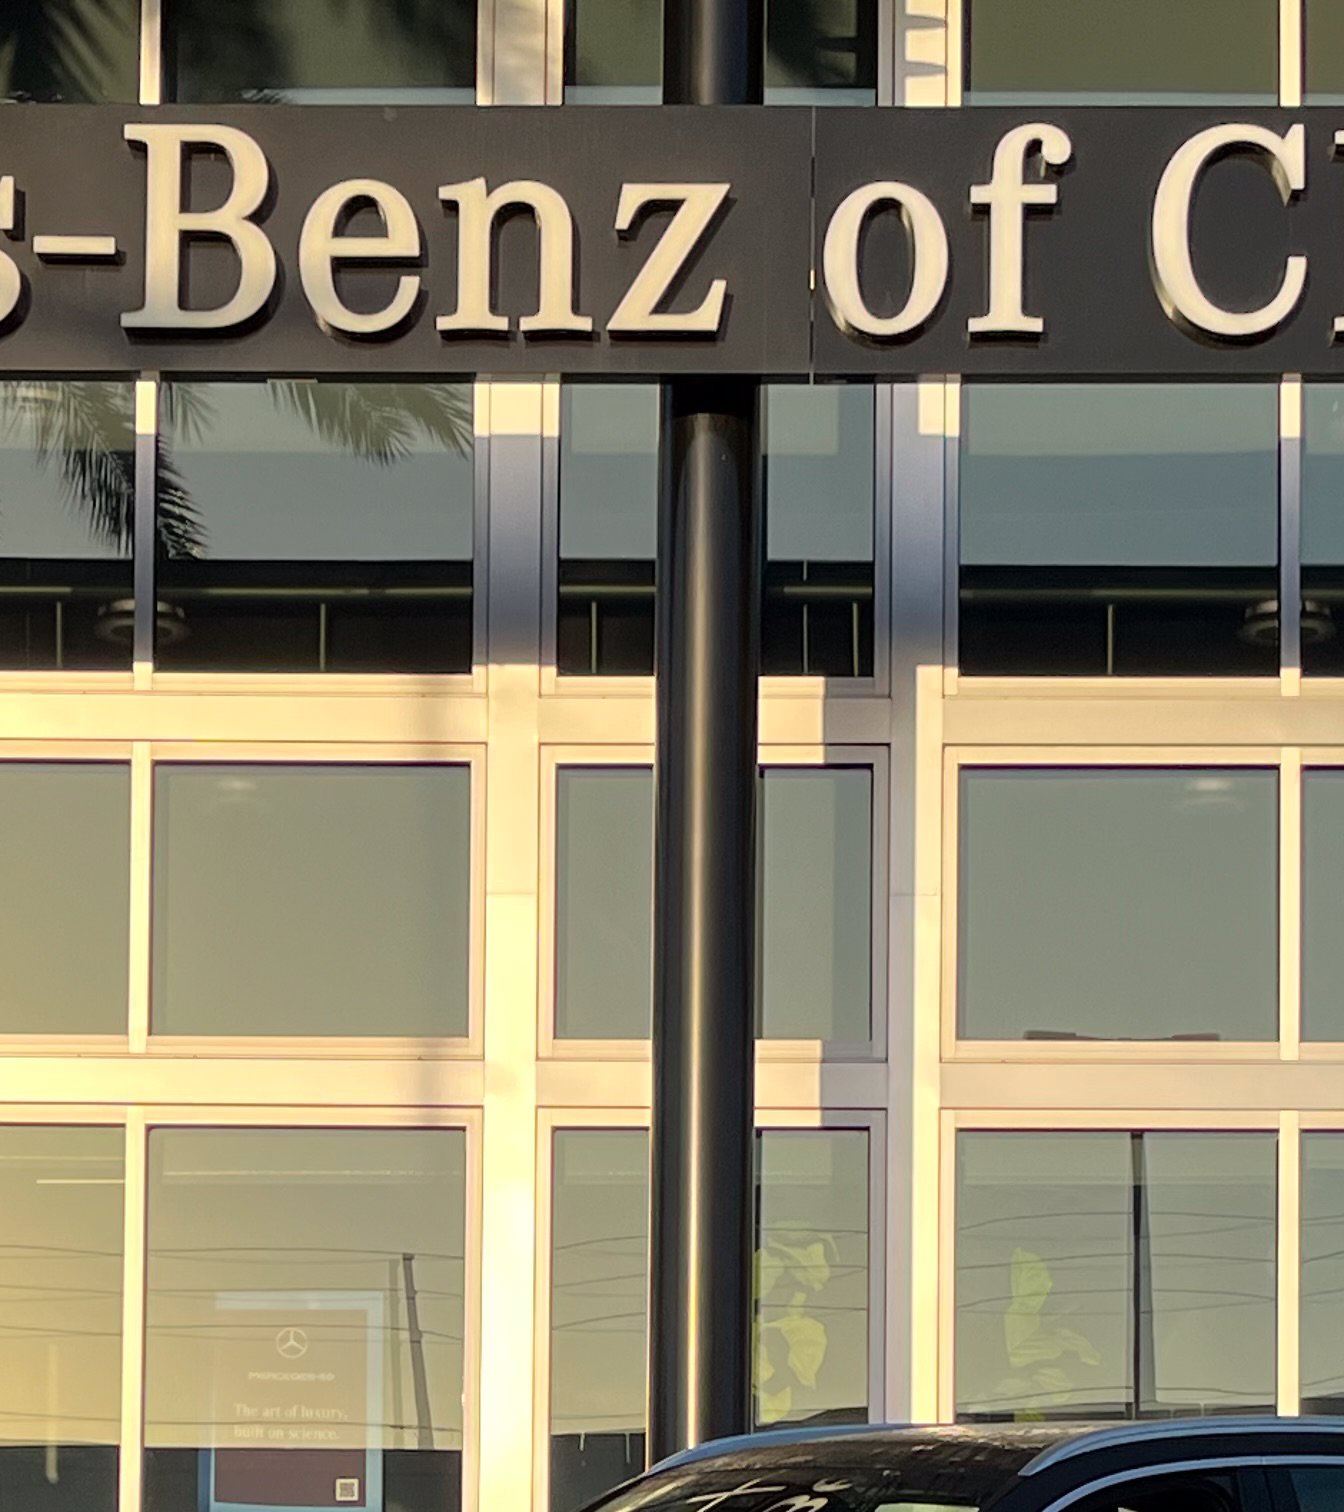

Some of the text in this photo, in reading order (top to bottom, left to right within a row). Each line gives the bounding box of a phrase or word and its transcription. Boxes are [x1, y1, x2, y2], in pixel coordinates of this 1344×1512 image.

[822, 122, 1072, 336] of
[233, 1403, 259, 1418] The
[262, 1406, 281, 1418] art
[284, 1404, 298, 1418] of
[269, 1428, 285, 1440] on
